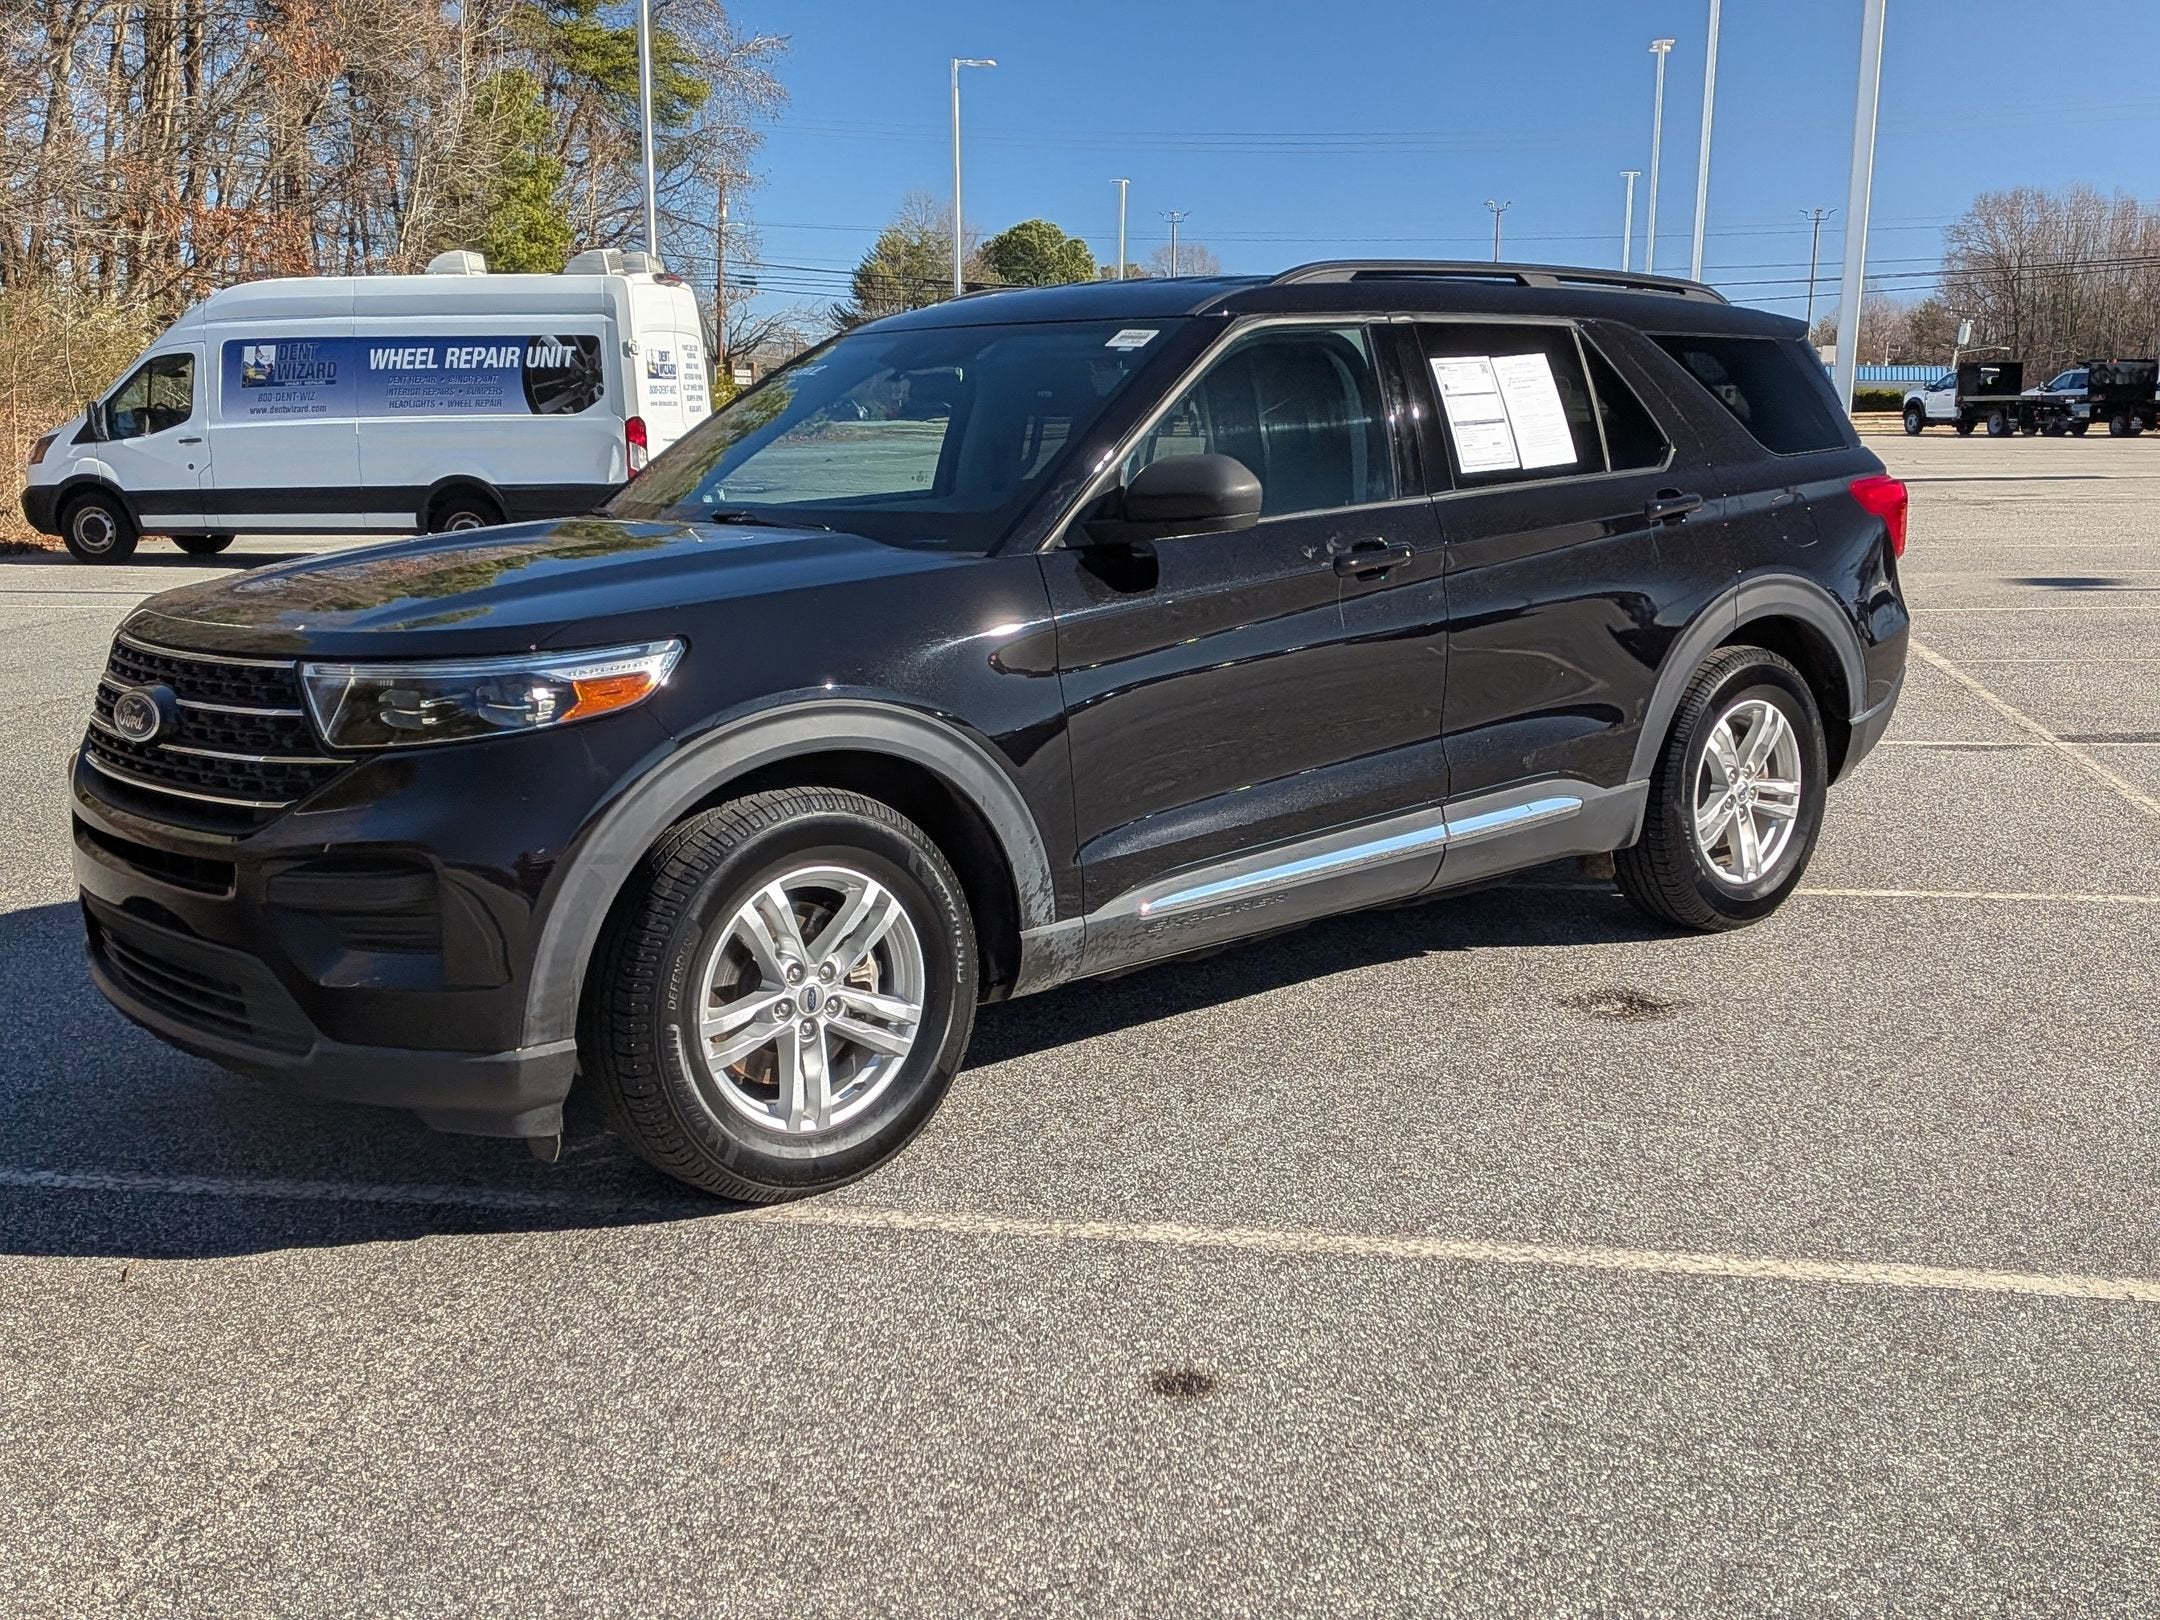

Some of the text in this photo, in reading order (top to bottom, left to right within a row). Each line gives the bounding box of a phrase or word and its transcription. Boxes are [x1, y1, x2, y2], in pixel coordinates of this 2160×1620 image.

[278, 343, 318, 361] DENT
[369, 346, 577, 370] WHEEL REPAIR UNIT
[659, 350, 670, 362] DENT
[276, 361, 337, 380] WIZARD
[257, 391, 316, 402] 800-DENT-WIZ
[386, 386, 504, 397] INTERIOR REPAIRS BUMPERS
[249, 404, 327, 415] www.dentwizard.com
[389, 399, 502, 409] HEADLIGHTS WHEEL REPAIR
[120, 701, 146, 730] Ford
[667, 938, 694, 1011] DEFENDER
